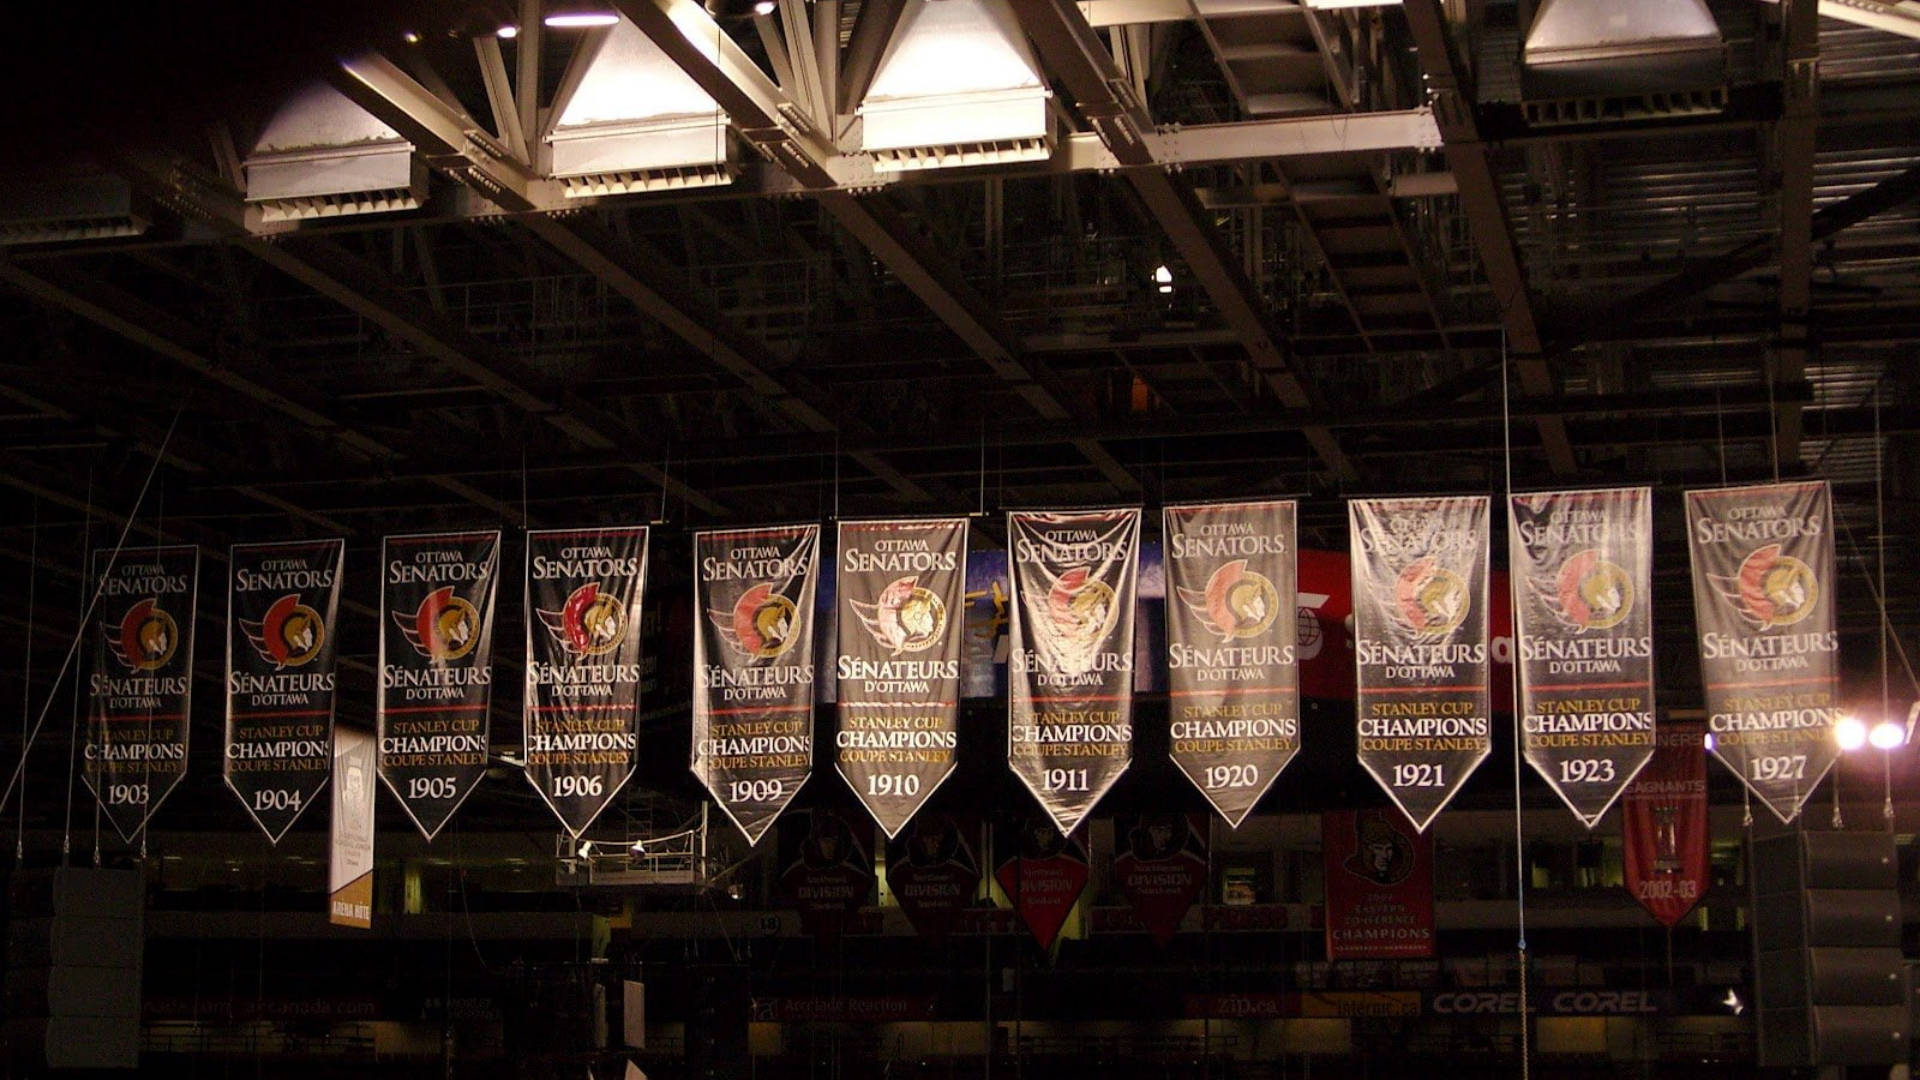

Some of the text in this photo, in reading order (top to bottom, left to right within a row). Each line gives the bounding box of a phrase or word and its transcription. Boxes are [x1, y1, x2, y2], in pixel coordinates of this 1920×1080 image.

[1728, 504, 1786, 520] OTTAWA
[1044, 529, 1098, 542] OTTAWA
[1200, 522, 1255, 536] OTTAWA
[1697, 514, 1821, 544] SENATORS
[561, 546, 612, 559] OTTAWA
[730, 546, 780, 560] OTTAWA
[874, 539, 929, 553] OTTAWA
[1016, 539, 1127, 564] SENATORS
[1171, 533, 1287, 559] SENATORS
[261, 560, 308, 573] OTTAWA
[415, 551, 463, 564] OTTAWA
[532, 555, 637, 579] SENATORS
[844, 548, 957, 573] SENATORS
[389, 559, 488, 583] SENATORS
[702, 555, 808, 581] SENATORS
[236, 568, 334, 592] SENATORS
[1358, 640, 1487, 666] SÉNATEURS
[1520, 636, 1651, 662] SÉNATEURS
[1702, 630, 1839, 660] SÉNATEURS
[1012, 647, 1133, 673] SÉNURS
[1168, 643, 1295, 669] SÉNATEURS
[1735, 656, 1809, 673] D'OTTAWA
[384, 664, 492, 688] SÉNATEURS
[527, 661, 640, 685] SÉNATEURS
[700, 663, 815, 689] SÉNATEURS
[837, 654, 959, 680] SÉNATEURS
[1197, 667, 1265, 682] D'OTTAWA
[1385, 665, 1455, 680] D'OTTAWA
[1548, 660, 1621, 675] D'OTTAWA
[89, 673, 187, 697] SÉNATEURS
[229, 671, 335, 696] SÉNATEURS
[405, 686, 465, 700] D'OTTAWA
[551, 683, 613, 698] D'OTTAWA
[864, 679, 930, 694] D'OTTAWA
[251, 694, 309, 707] D'OTTAWA
[723, 686, 786, 701] D'OTTAWA
[1183, 703, 1283, 719] STANLEY CUP
[1372, 702, 1473, 717] STANLEY CUP
[1536, 698, 1640, 714] STANLEY CUP
[393, 719, 480, 733] STANLEY CUP
[535, 718, 625, 733] STANLEY CUP
[848, 716, 944, 730] STANLEY CUP
[1089, 710, 1120, 724] CUP
[1524, 712, 1651, 734] CHAMPIONS
[1709, 708, 1846, 733] CHAMPIONS
[98, 729, 147, 742] TANLEY
[240, 725, 324, 740] STANLEY CUP
[711, 720, 803, 736] STANLEY CUP
[1012, 724, 1132, 743] CHAMPIONS
[1170, 719, 1297, 740] CHAMPIONS
[1357, 718, 1487, 738] CHAMPIONS
[1773, 729, 1842, 745] STANL
[380, 734, 487, 754] CHAMPIONS
[527, 733, 636, 753] CHAMPIONS
[698, 735, 810, 757] CHAMPIONS
[836, 730, 958, 750] CHAMPIONS
[1175, 738, 1292, 754] COUPE STANLEY
[1362, 737, 1480, 751] COUPE STANLEY
[1529, 731, 1650, 748] COUPE STANLEY
[84, 743, 185, 761] CHAMPIONS
[226, 741, 330, 759] CHAMPIONS
[570, 751, 630, 765] STANLEY
[840, 747, 951, 763] COUPE STANLEY
[1013, 743, 1128, 757] COUPE STANLEY
[230, 760, 274, 773] COUPE
[383, 754, 427, 767] COUPE
[1750, 756, 1807, 780] 1927
[1042, 769, 1089, 792] 1911
[1205, 764, 1259, 789] 1920
[1393, 763, 1445, 787] 1921
[1560, 759, 1615, 783] 1923
[108, 784, 149, 805] 1903
[408, 776, 457, 799] 1905
[553, 775, 603, 798] 1906
[729, 779, 782, 803] 1909
[867, 774, 920, 797] 1910
[252, 789, 301, 812] 1904
[1127, 873, 1193, 887] DIVISION
[1639, 880, 1697, 899] 2002-03
[1332, 928, 1431, 940] CHAMPIONS
[1433, 992, 1537, 1013] COREL
[1552, 991, 1658, 1013] COREL
